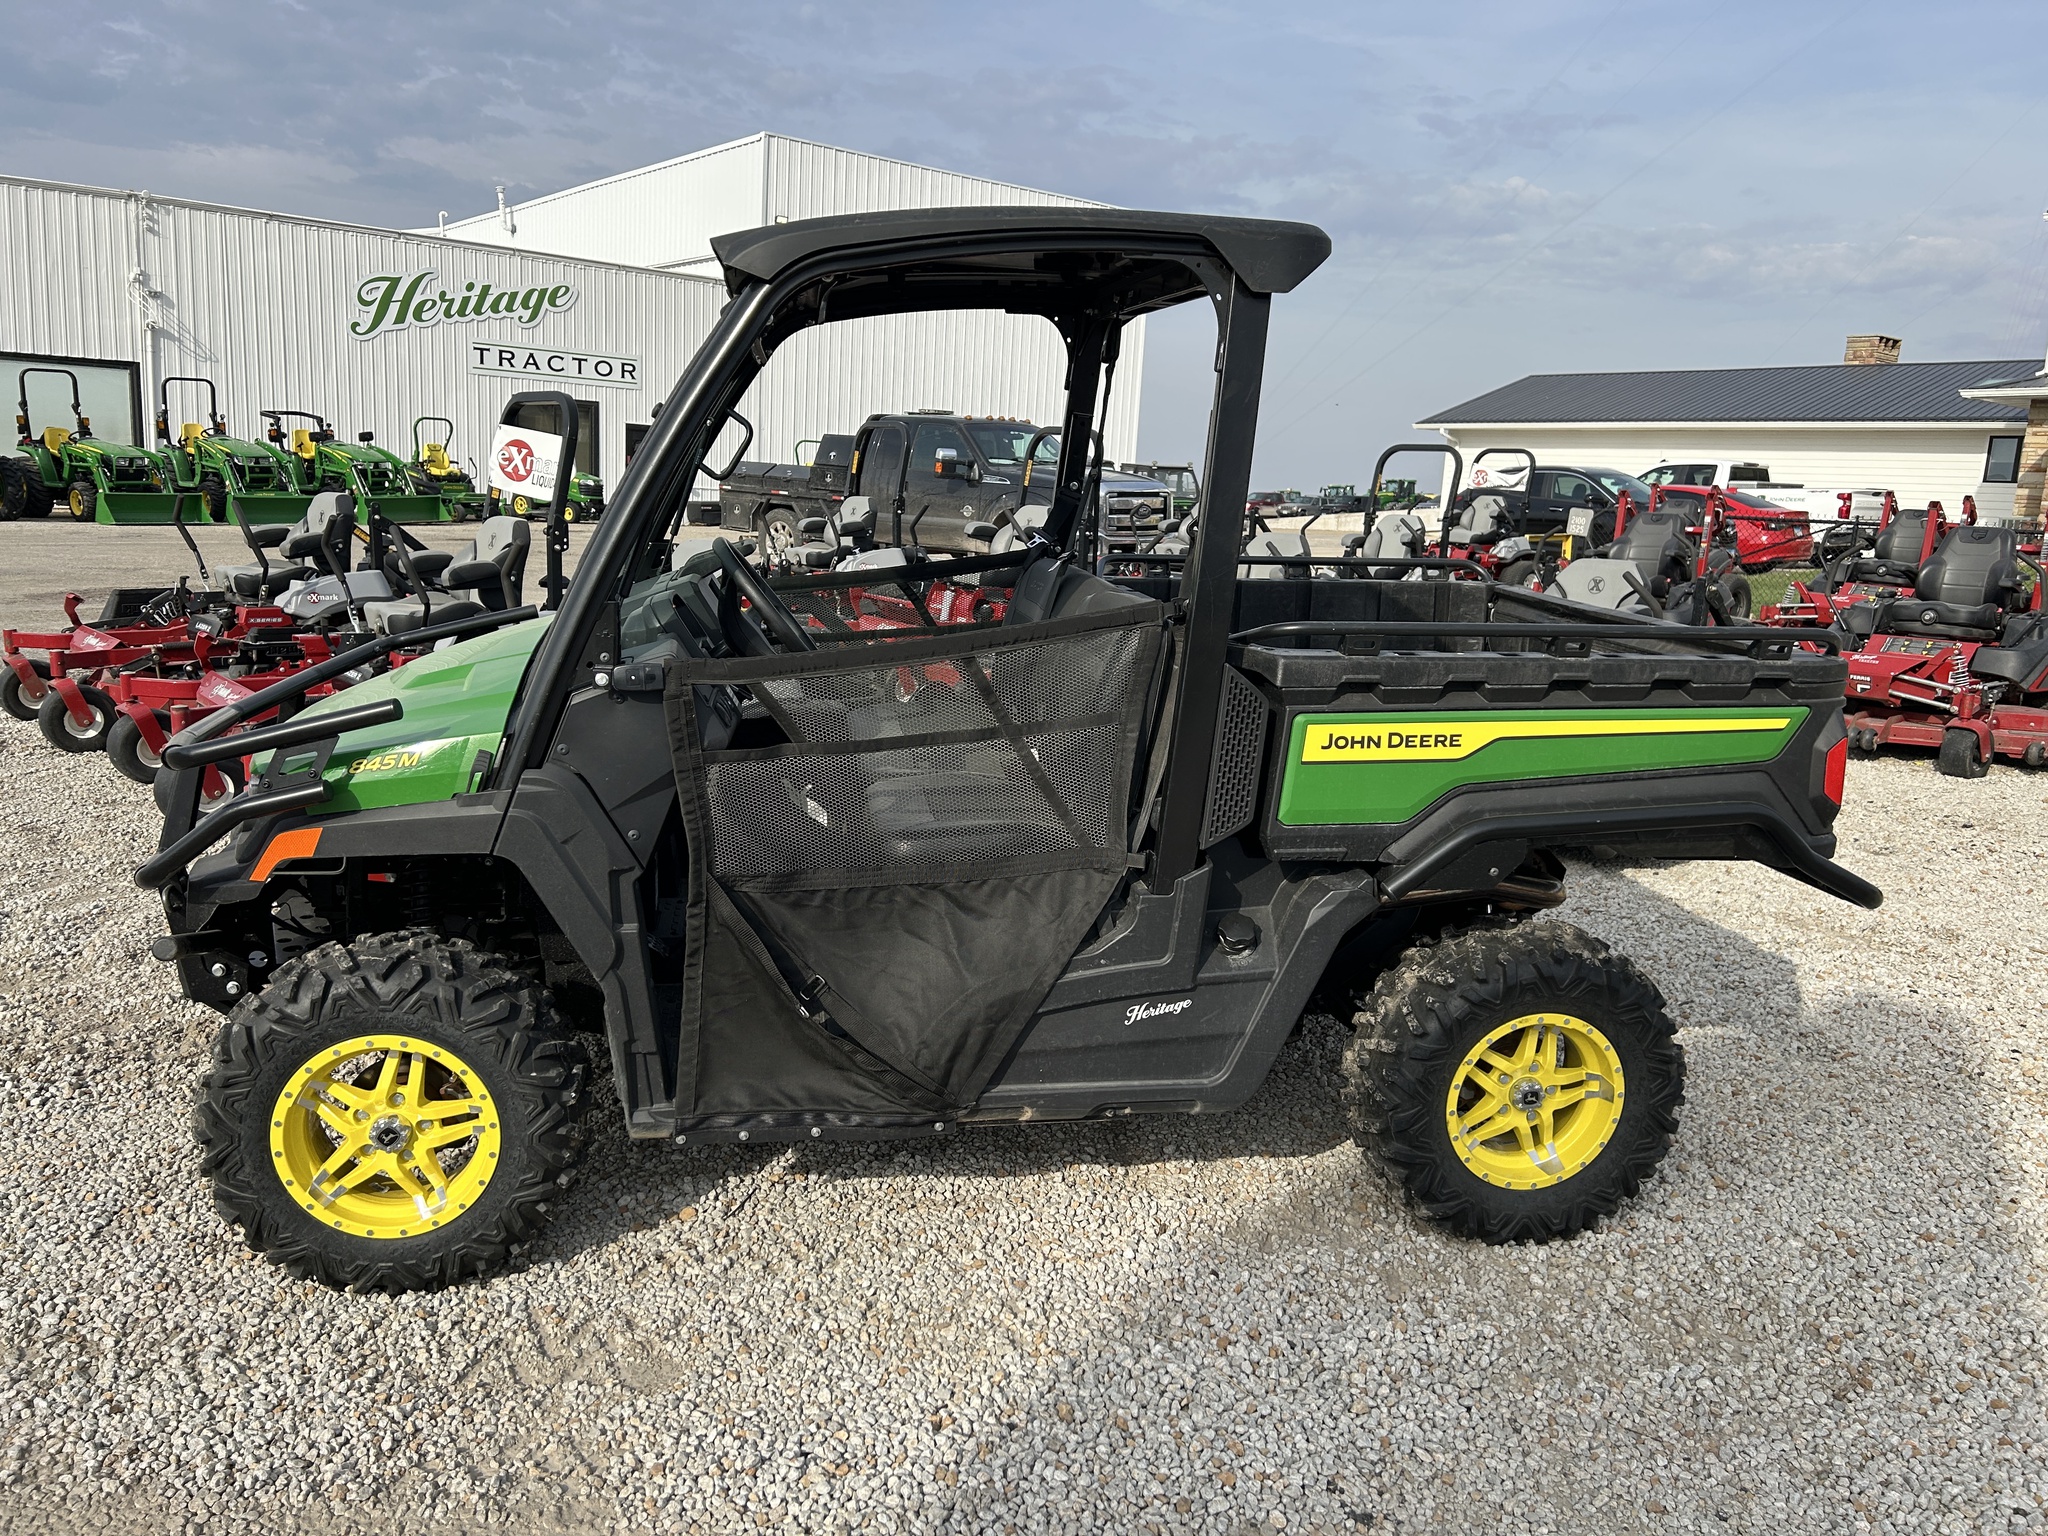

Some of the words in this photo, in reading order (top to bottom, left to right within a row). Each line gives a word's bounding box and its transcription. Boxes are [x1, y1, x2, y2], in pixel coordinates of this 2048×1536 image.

[350, 271, 575, 336] Heritage
[473, 346, 637, 380] TRACTOR
[1569, 524, 1584, 533] 1525
[1571, 515, 1586, 525] 2100
[1320, 733, 1381, 750] JOHN
[1387, 732, 1462, 749] DEERE
[1124, 998, 1193, 1026] Heritage
